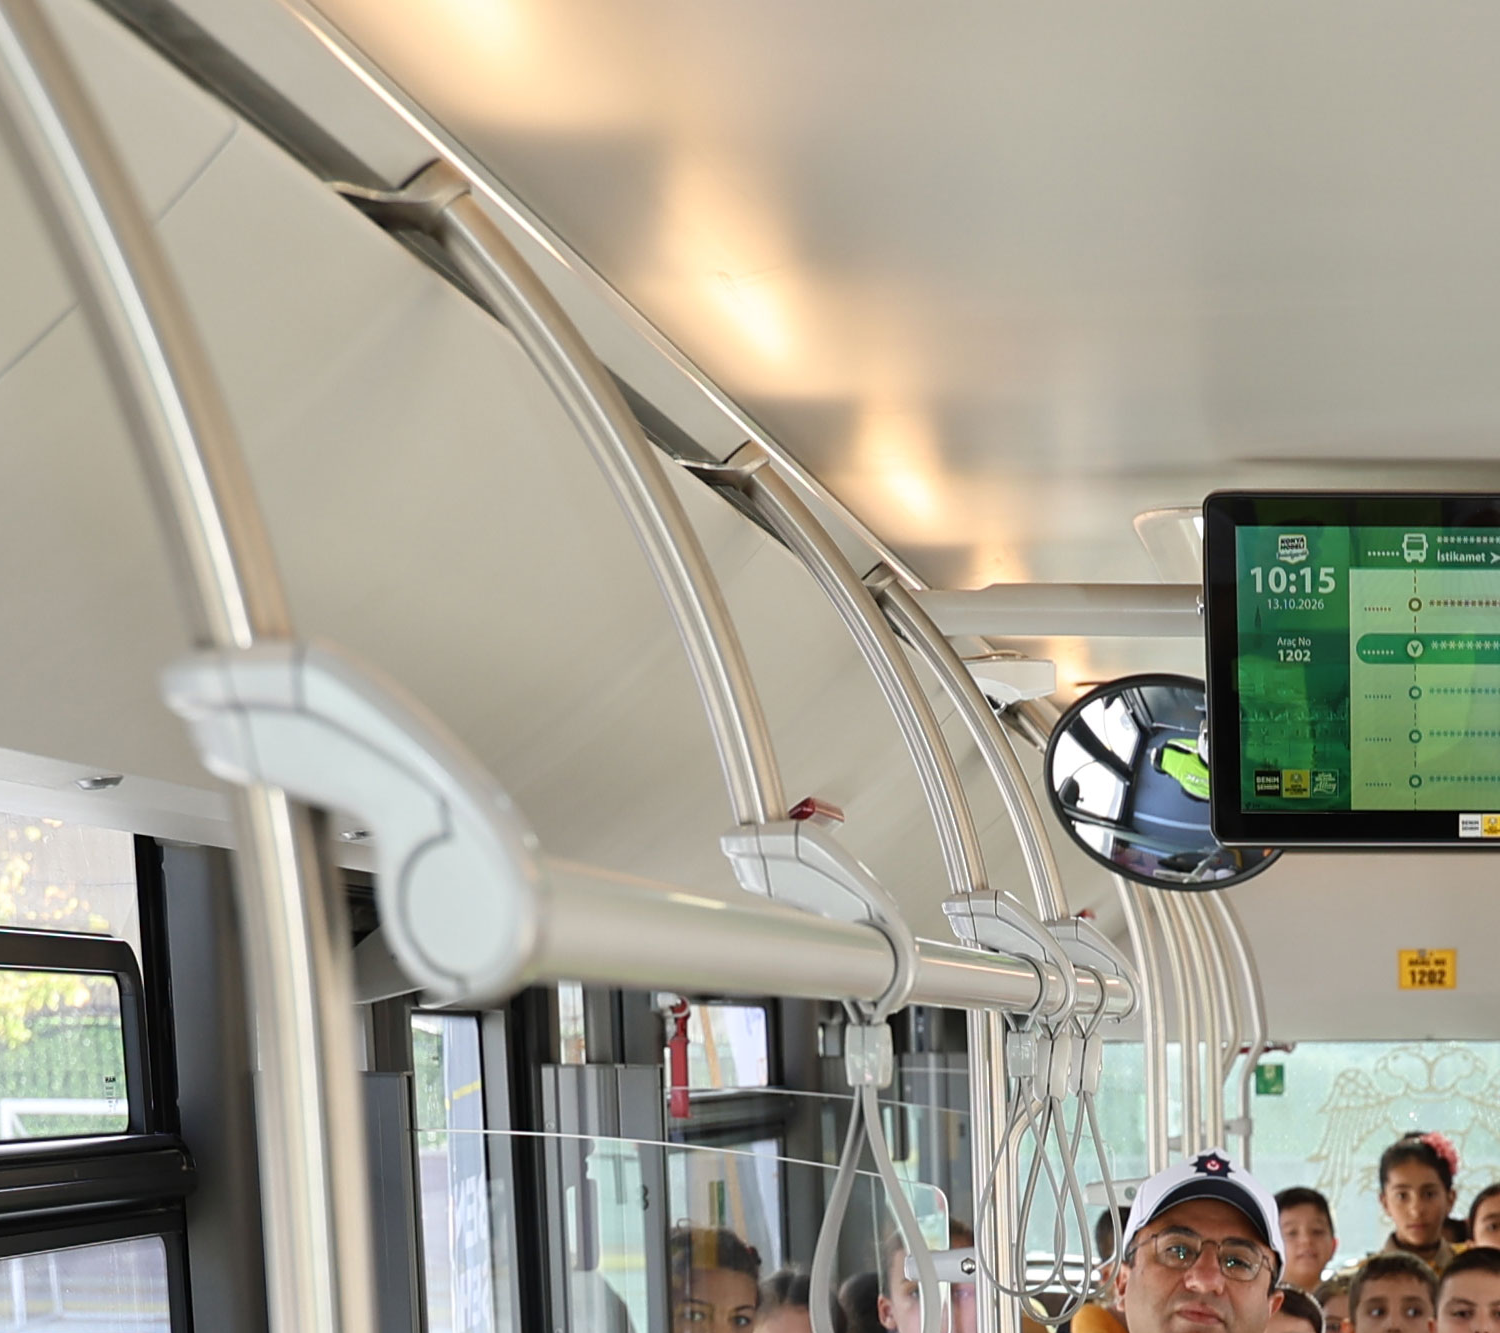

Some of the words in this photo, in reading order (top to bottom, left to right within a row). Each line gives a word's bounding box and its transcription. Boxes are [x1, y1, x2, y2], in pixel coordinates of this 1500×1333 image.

[1436, 549, 1486, 563] İstikamet
[1250, 566, 1336, 594] 10:15
[1267, 598, 1325, 610] 13.10.2026
[1276, 637, 1296, 648] Araç
[1298, 637, 1312, 646] No
[1277, 649, 1311, 662] 1202
[1410, 969, 1446, 986] 1202
